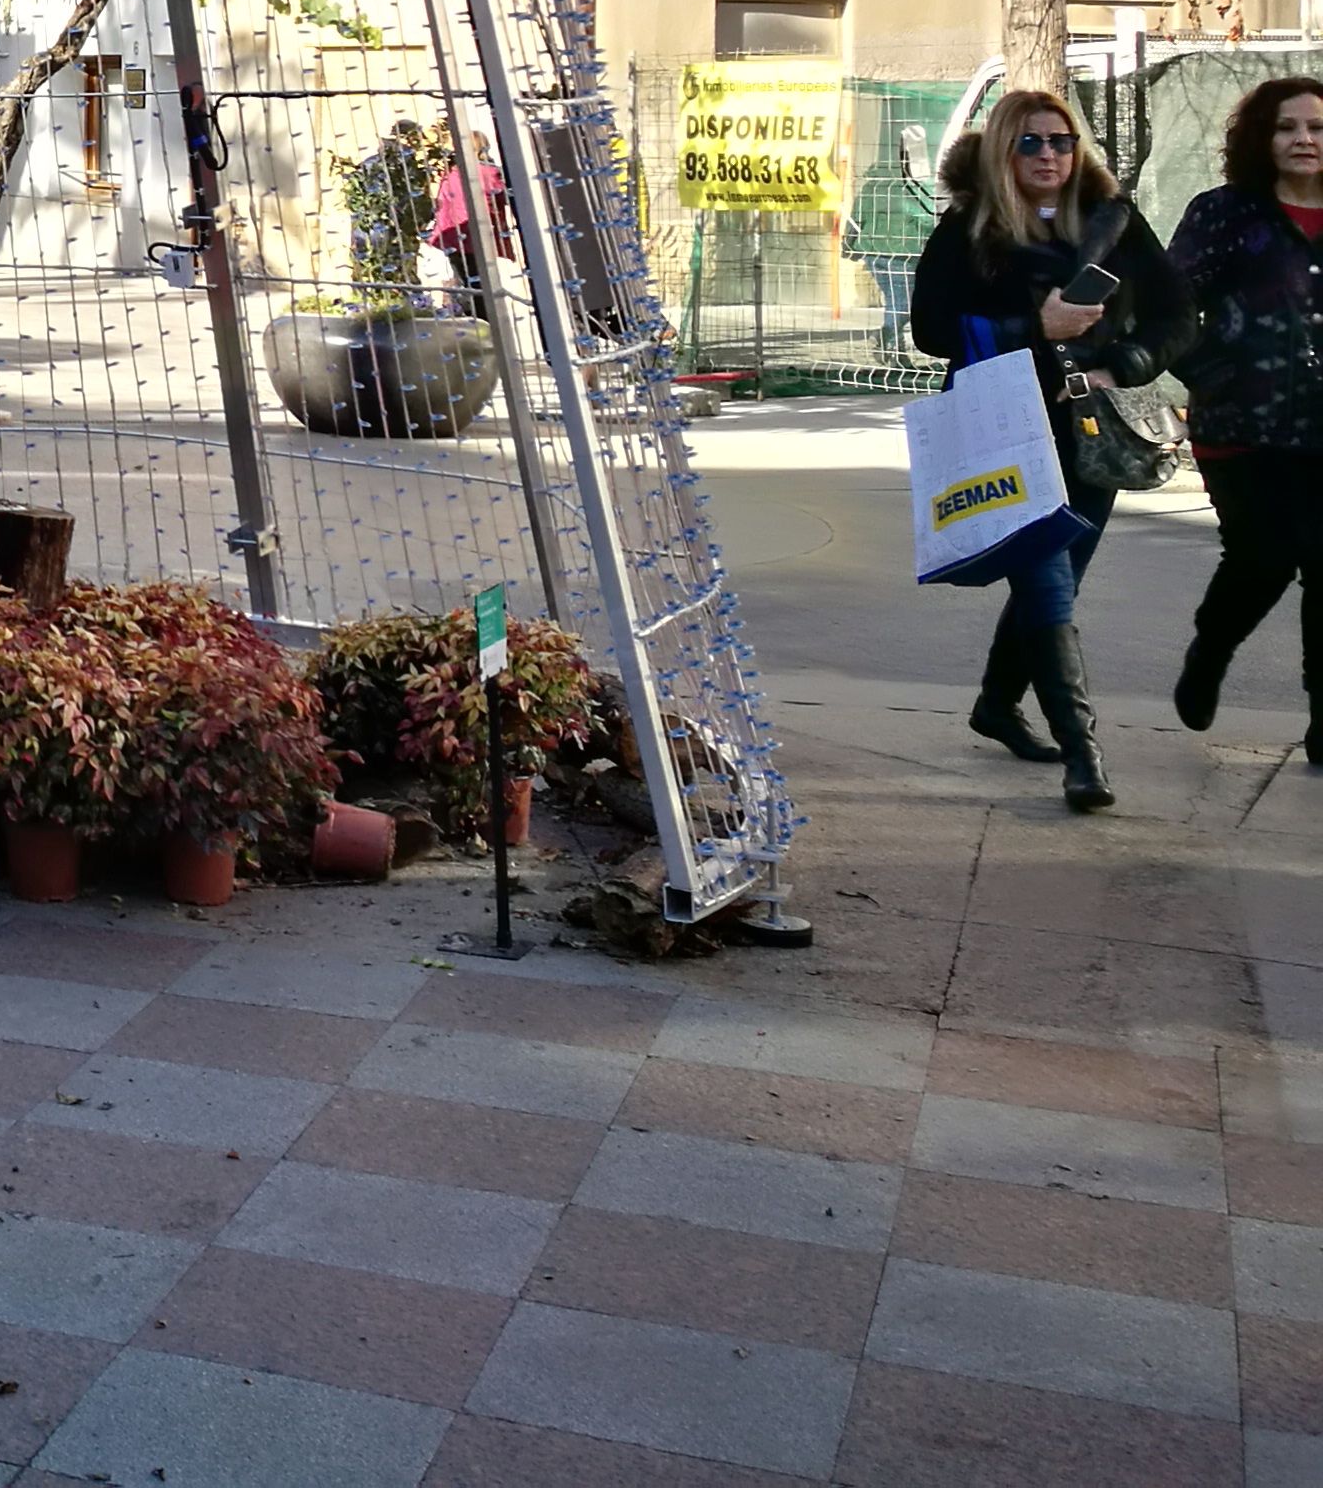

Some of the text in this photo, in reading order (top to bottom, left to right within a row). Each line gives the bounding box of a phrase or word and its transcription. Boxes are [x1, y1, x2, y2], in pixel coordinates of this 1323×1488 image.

[777, 79, 837, 92] Europeas
[686, 115, 826, 140] DISPONIBLE
[685, 152, 821, 185] 93.588.31.58
[937, 475, 1019, 521] ZEEMAN
